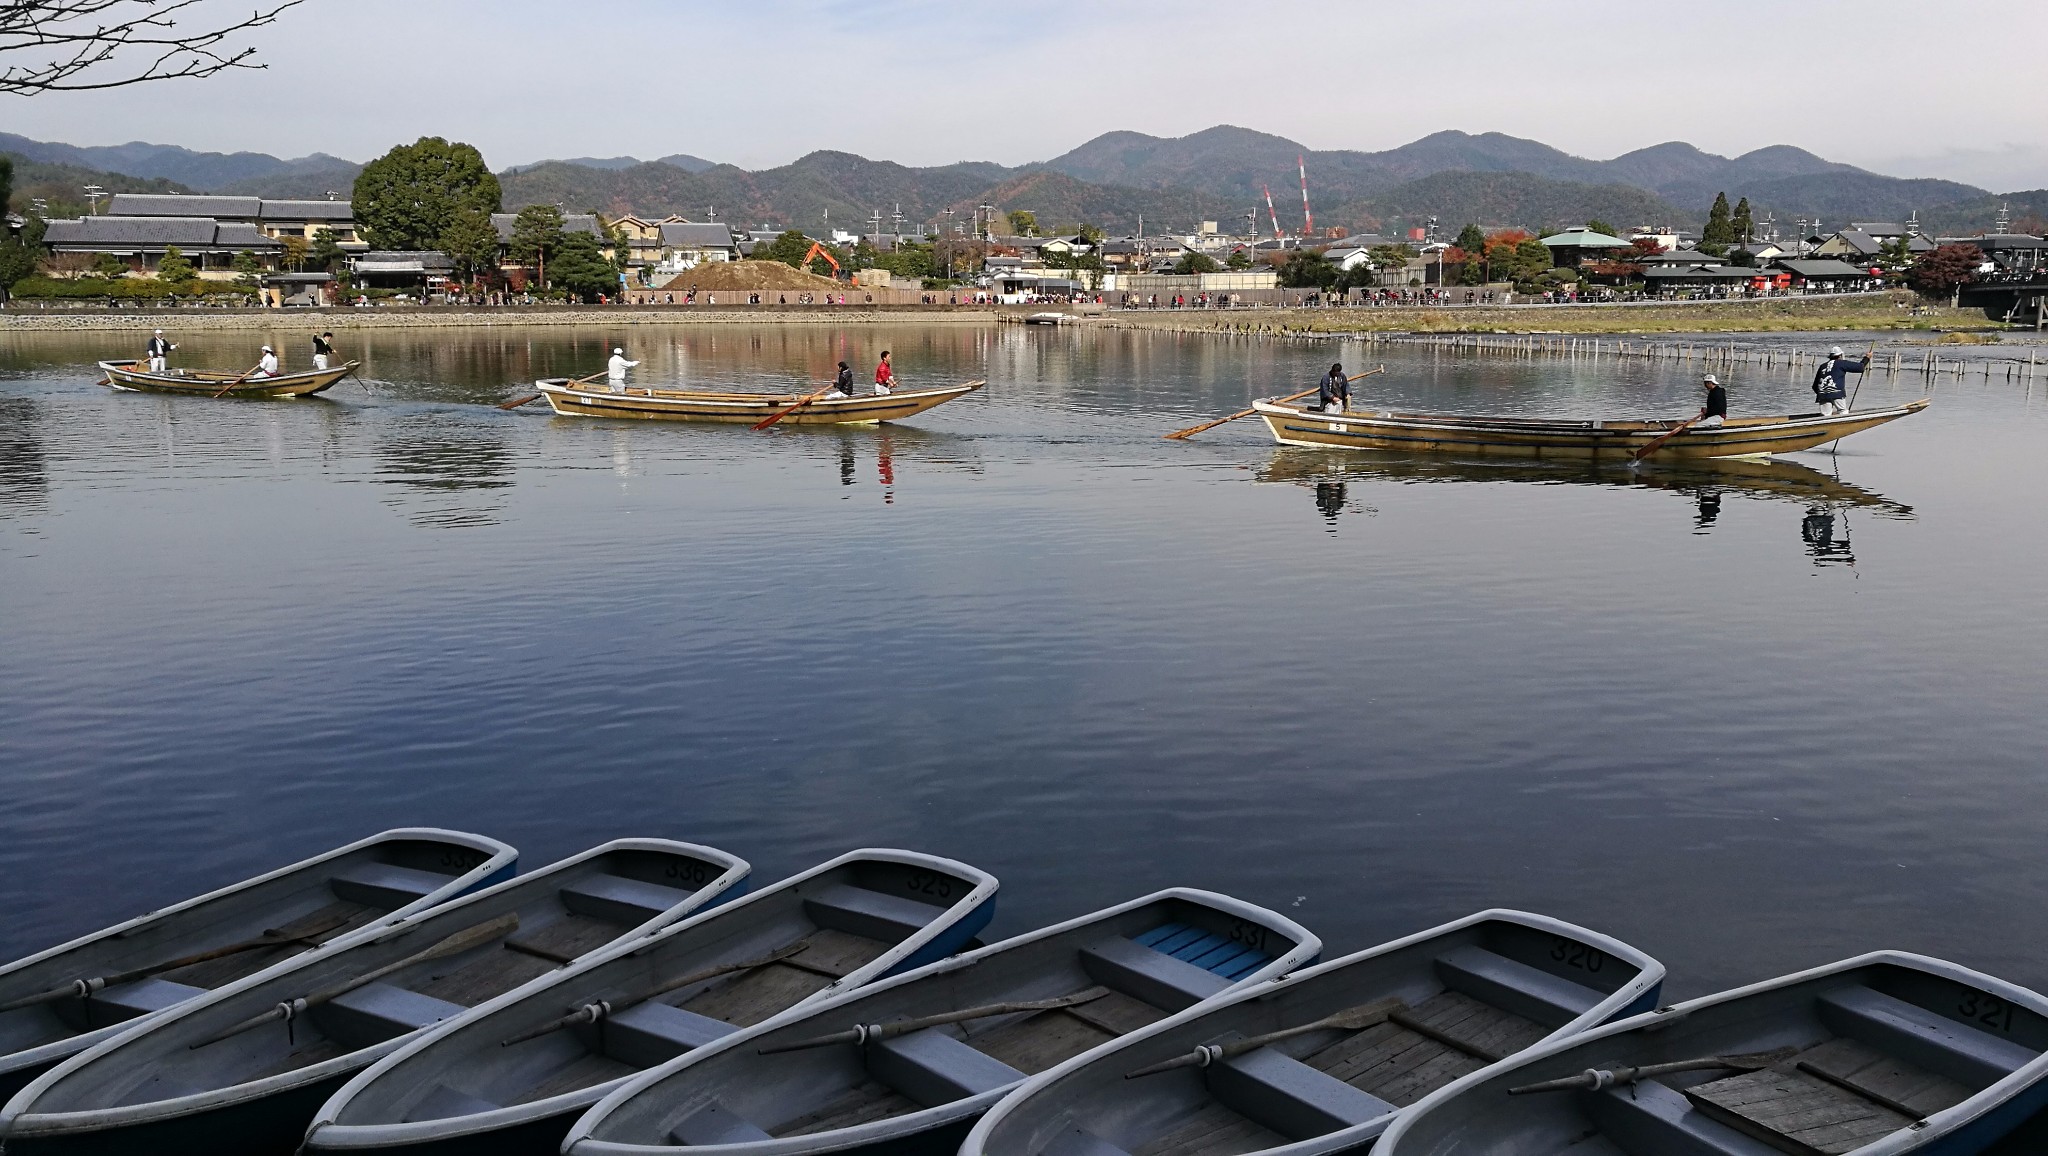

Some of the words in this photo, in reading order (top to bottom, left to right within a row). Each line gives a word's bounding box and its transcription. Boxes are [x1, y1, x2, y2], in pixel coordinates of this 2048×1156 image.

[666, 858, 705, 883] 336
[908, 872, 951, 898] 325
[1230, 918, 1266, 950] 331
[1550, 938, 1603, 973] 320
[1958, 987, 2013, 1033] 321
